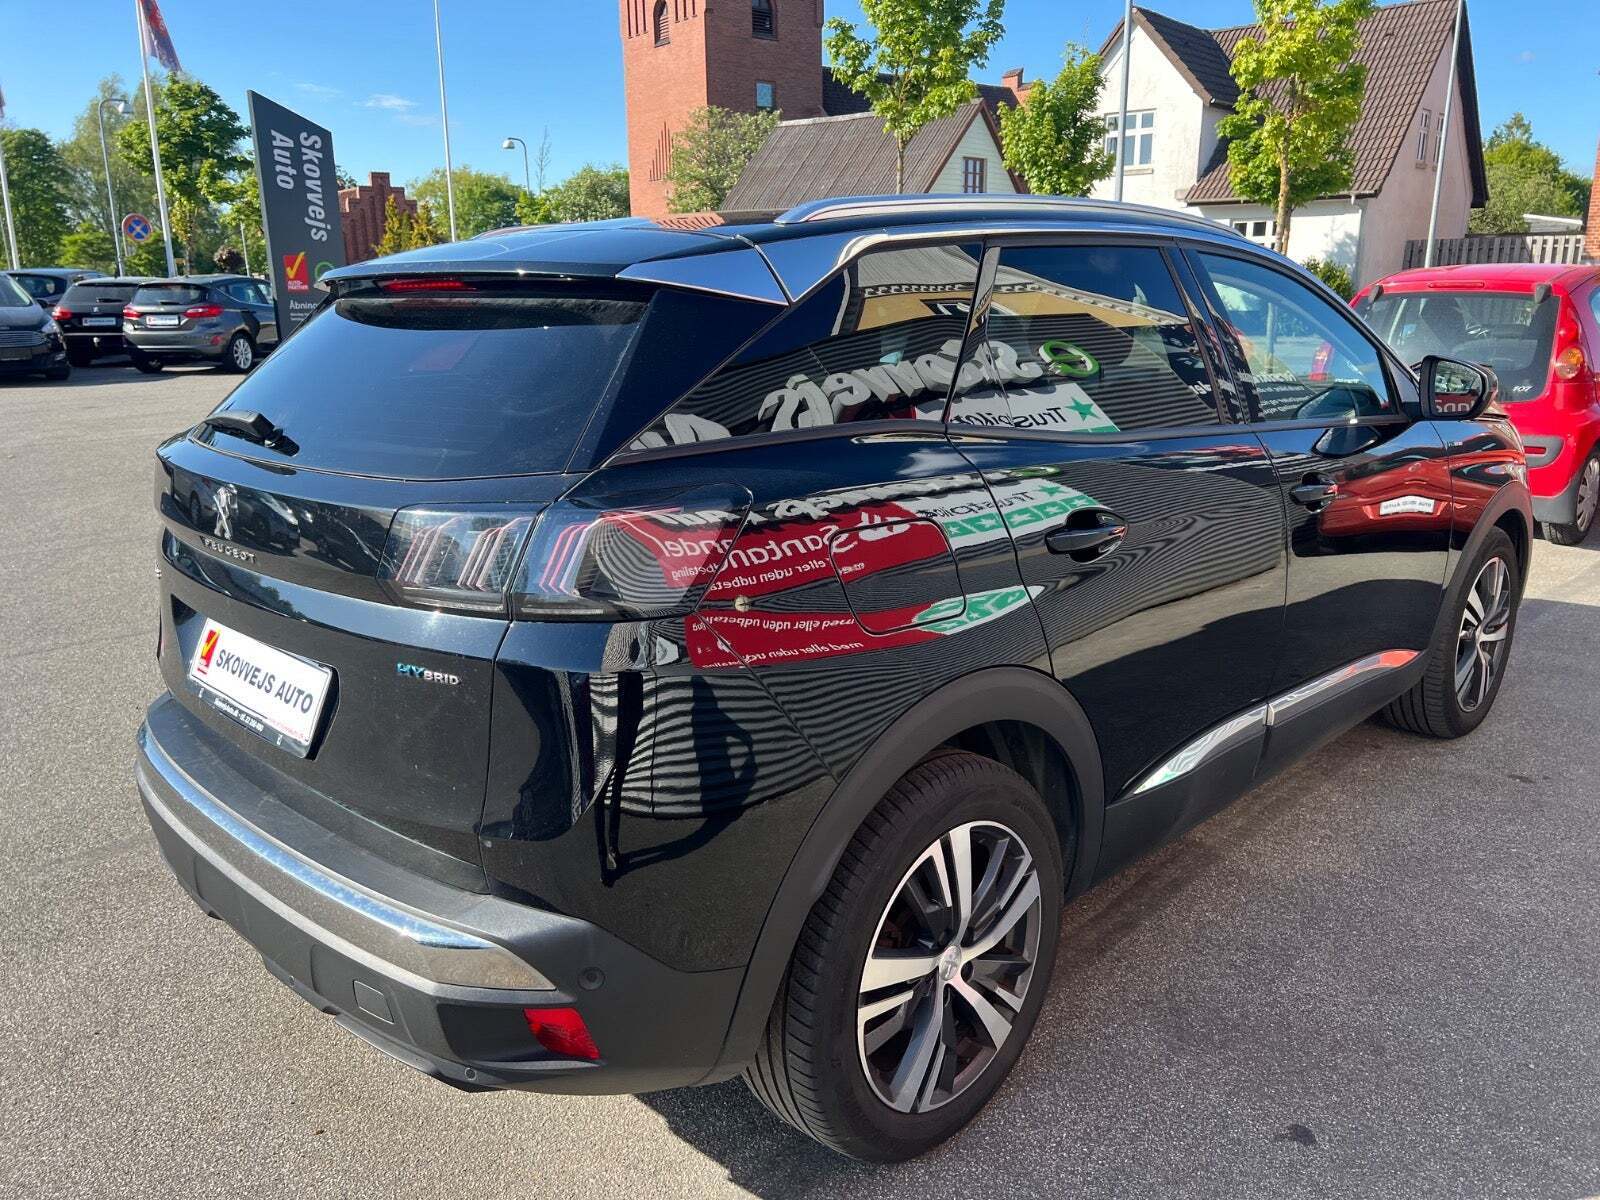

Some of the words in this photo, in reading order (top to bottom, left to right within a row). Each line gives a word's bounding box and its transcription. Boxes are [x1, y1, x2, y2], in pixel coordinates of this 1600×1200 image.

[270, 129, 298, 190] Auto
[300, 131, 331, 242] Skovvejs
[204, 537, 257, 564] PEUGEOT
[215, 648, 276, 694] SKOVVEJS
[274, 681, 314, 714] AUTO
[396, 663, 461, 686] HYBRID
